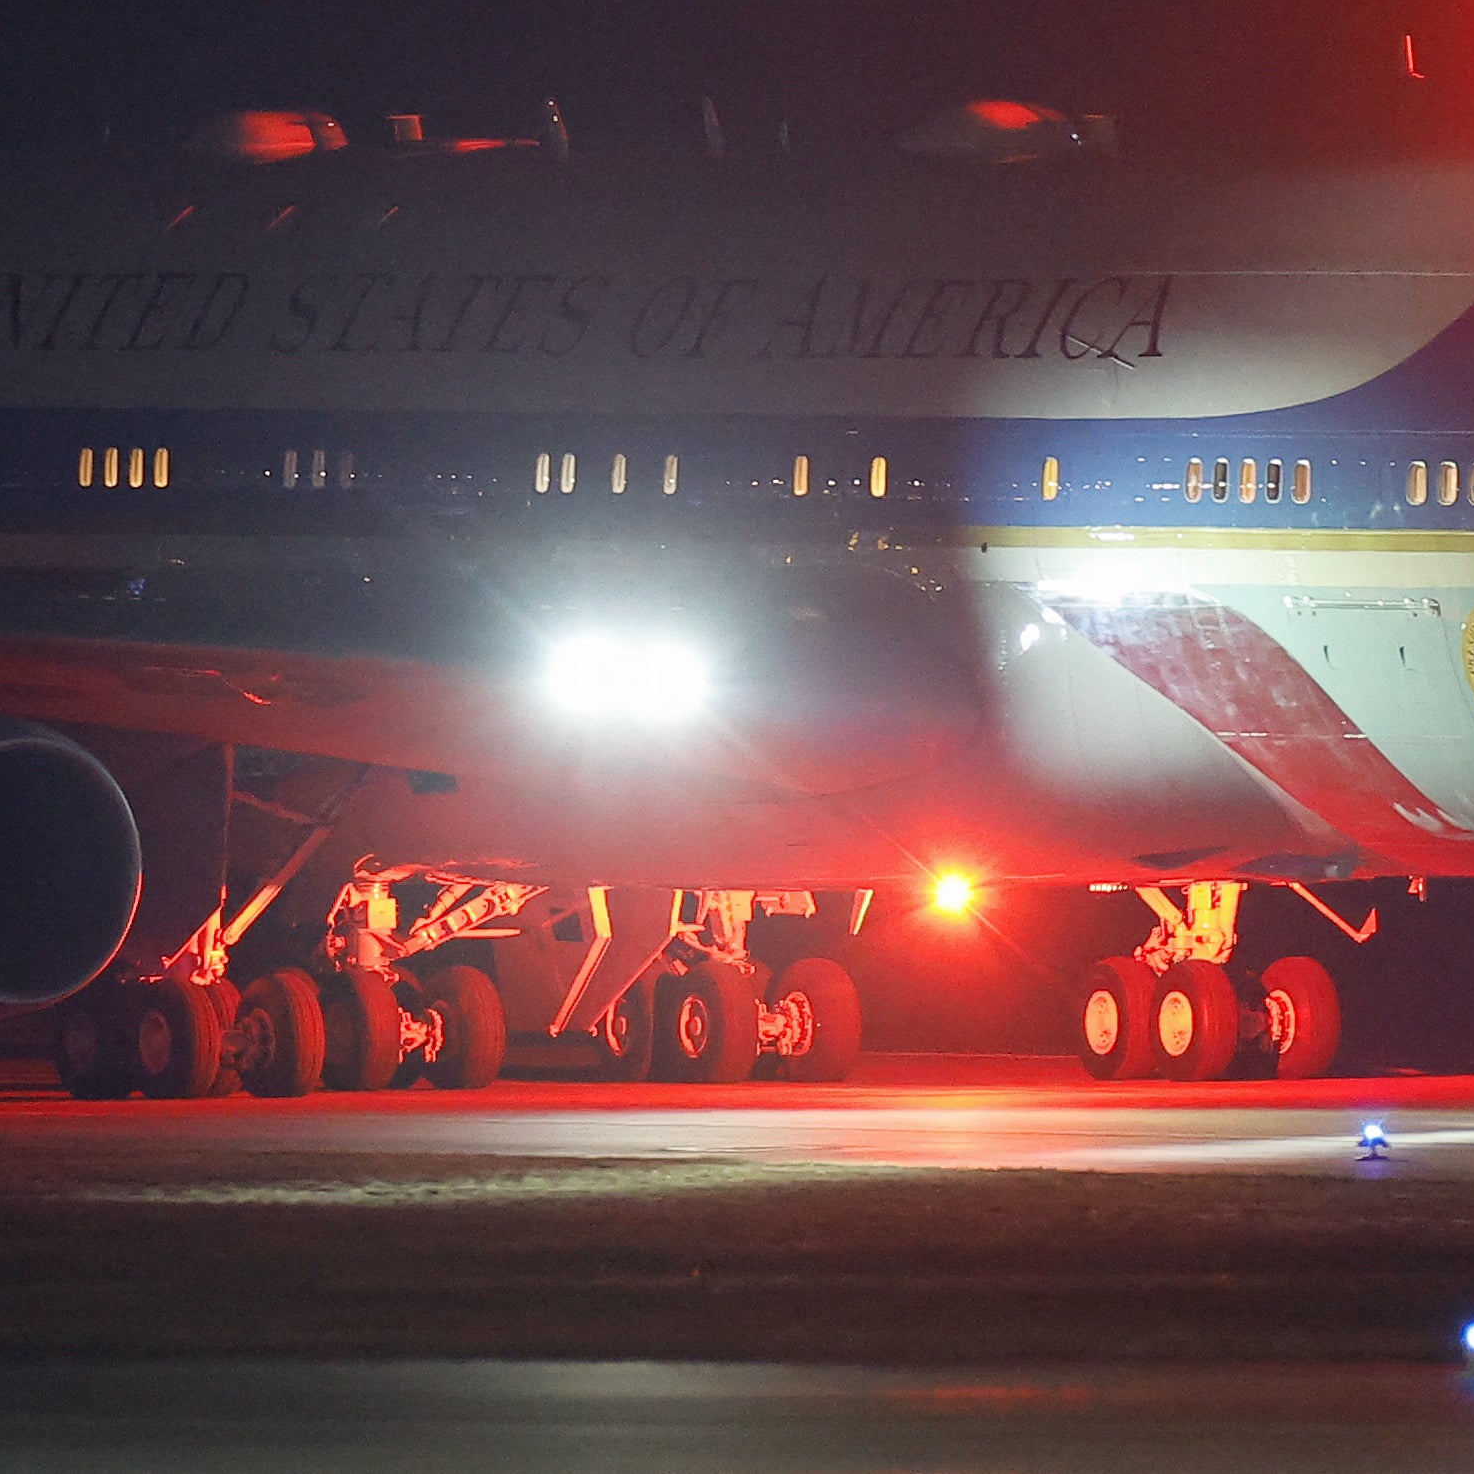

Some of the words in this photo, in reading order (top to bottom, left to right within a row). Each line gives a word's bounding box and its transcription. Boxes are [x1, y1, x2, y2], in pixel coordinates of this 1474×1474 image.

[268, 270, 612, 358] STATES
[627, 273, 758, 359] OF
[755, 273, 1175, 360] AMERICA
